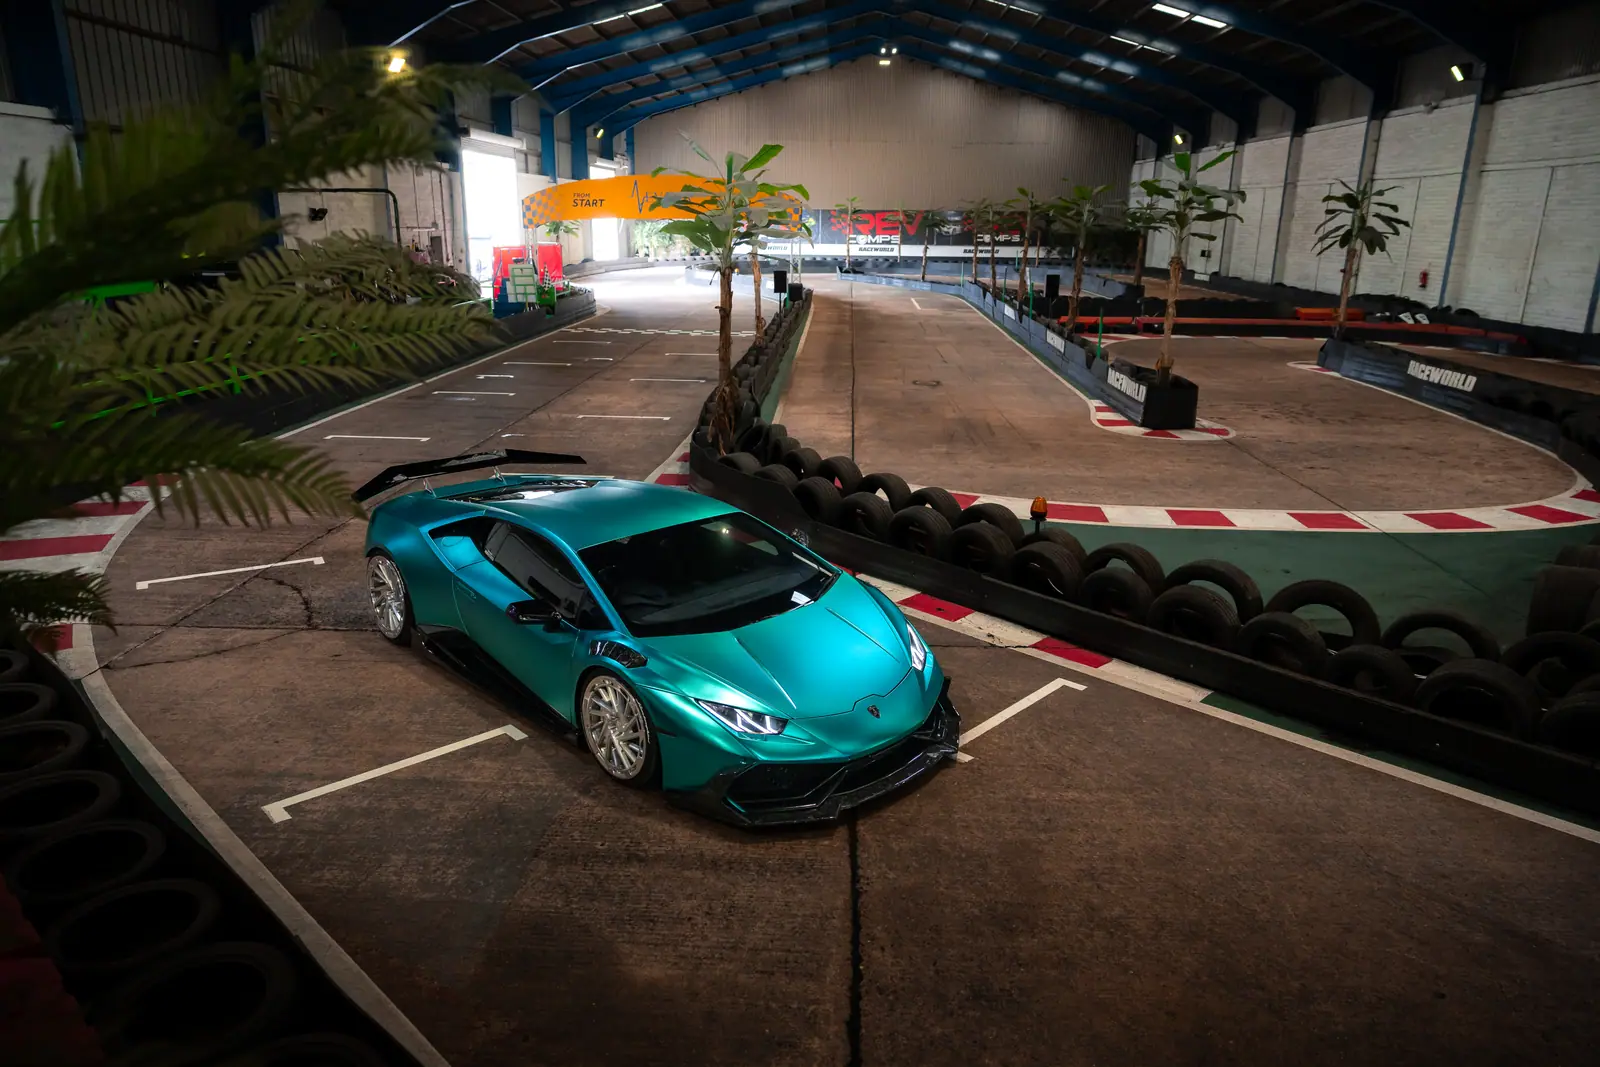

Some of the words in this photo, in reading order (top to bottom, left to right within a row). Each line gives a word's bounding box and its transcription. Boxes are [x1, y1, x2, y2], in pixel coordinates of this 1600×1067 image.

[572, 199, 605, 207] START
[848, 210, 926, 236] REV
[1107, 367, 1147, 402] RACEWORLD
[1407, 360, 1477, 393] RACEWORLD
